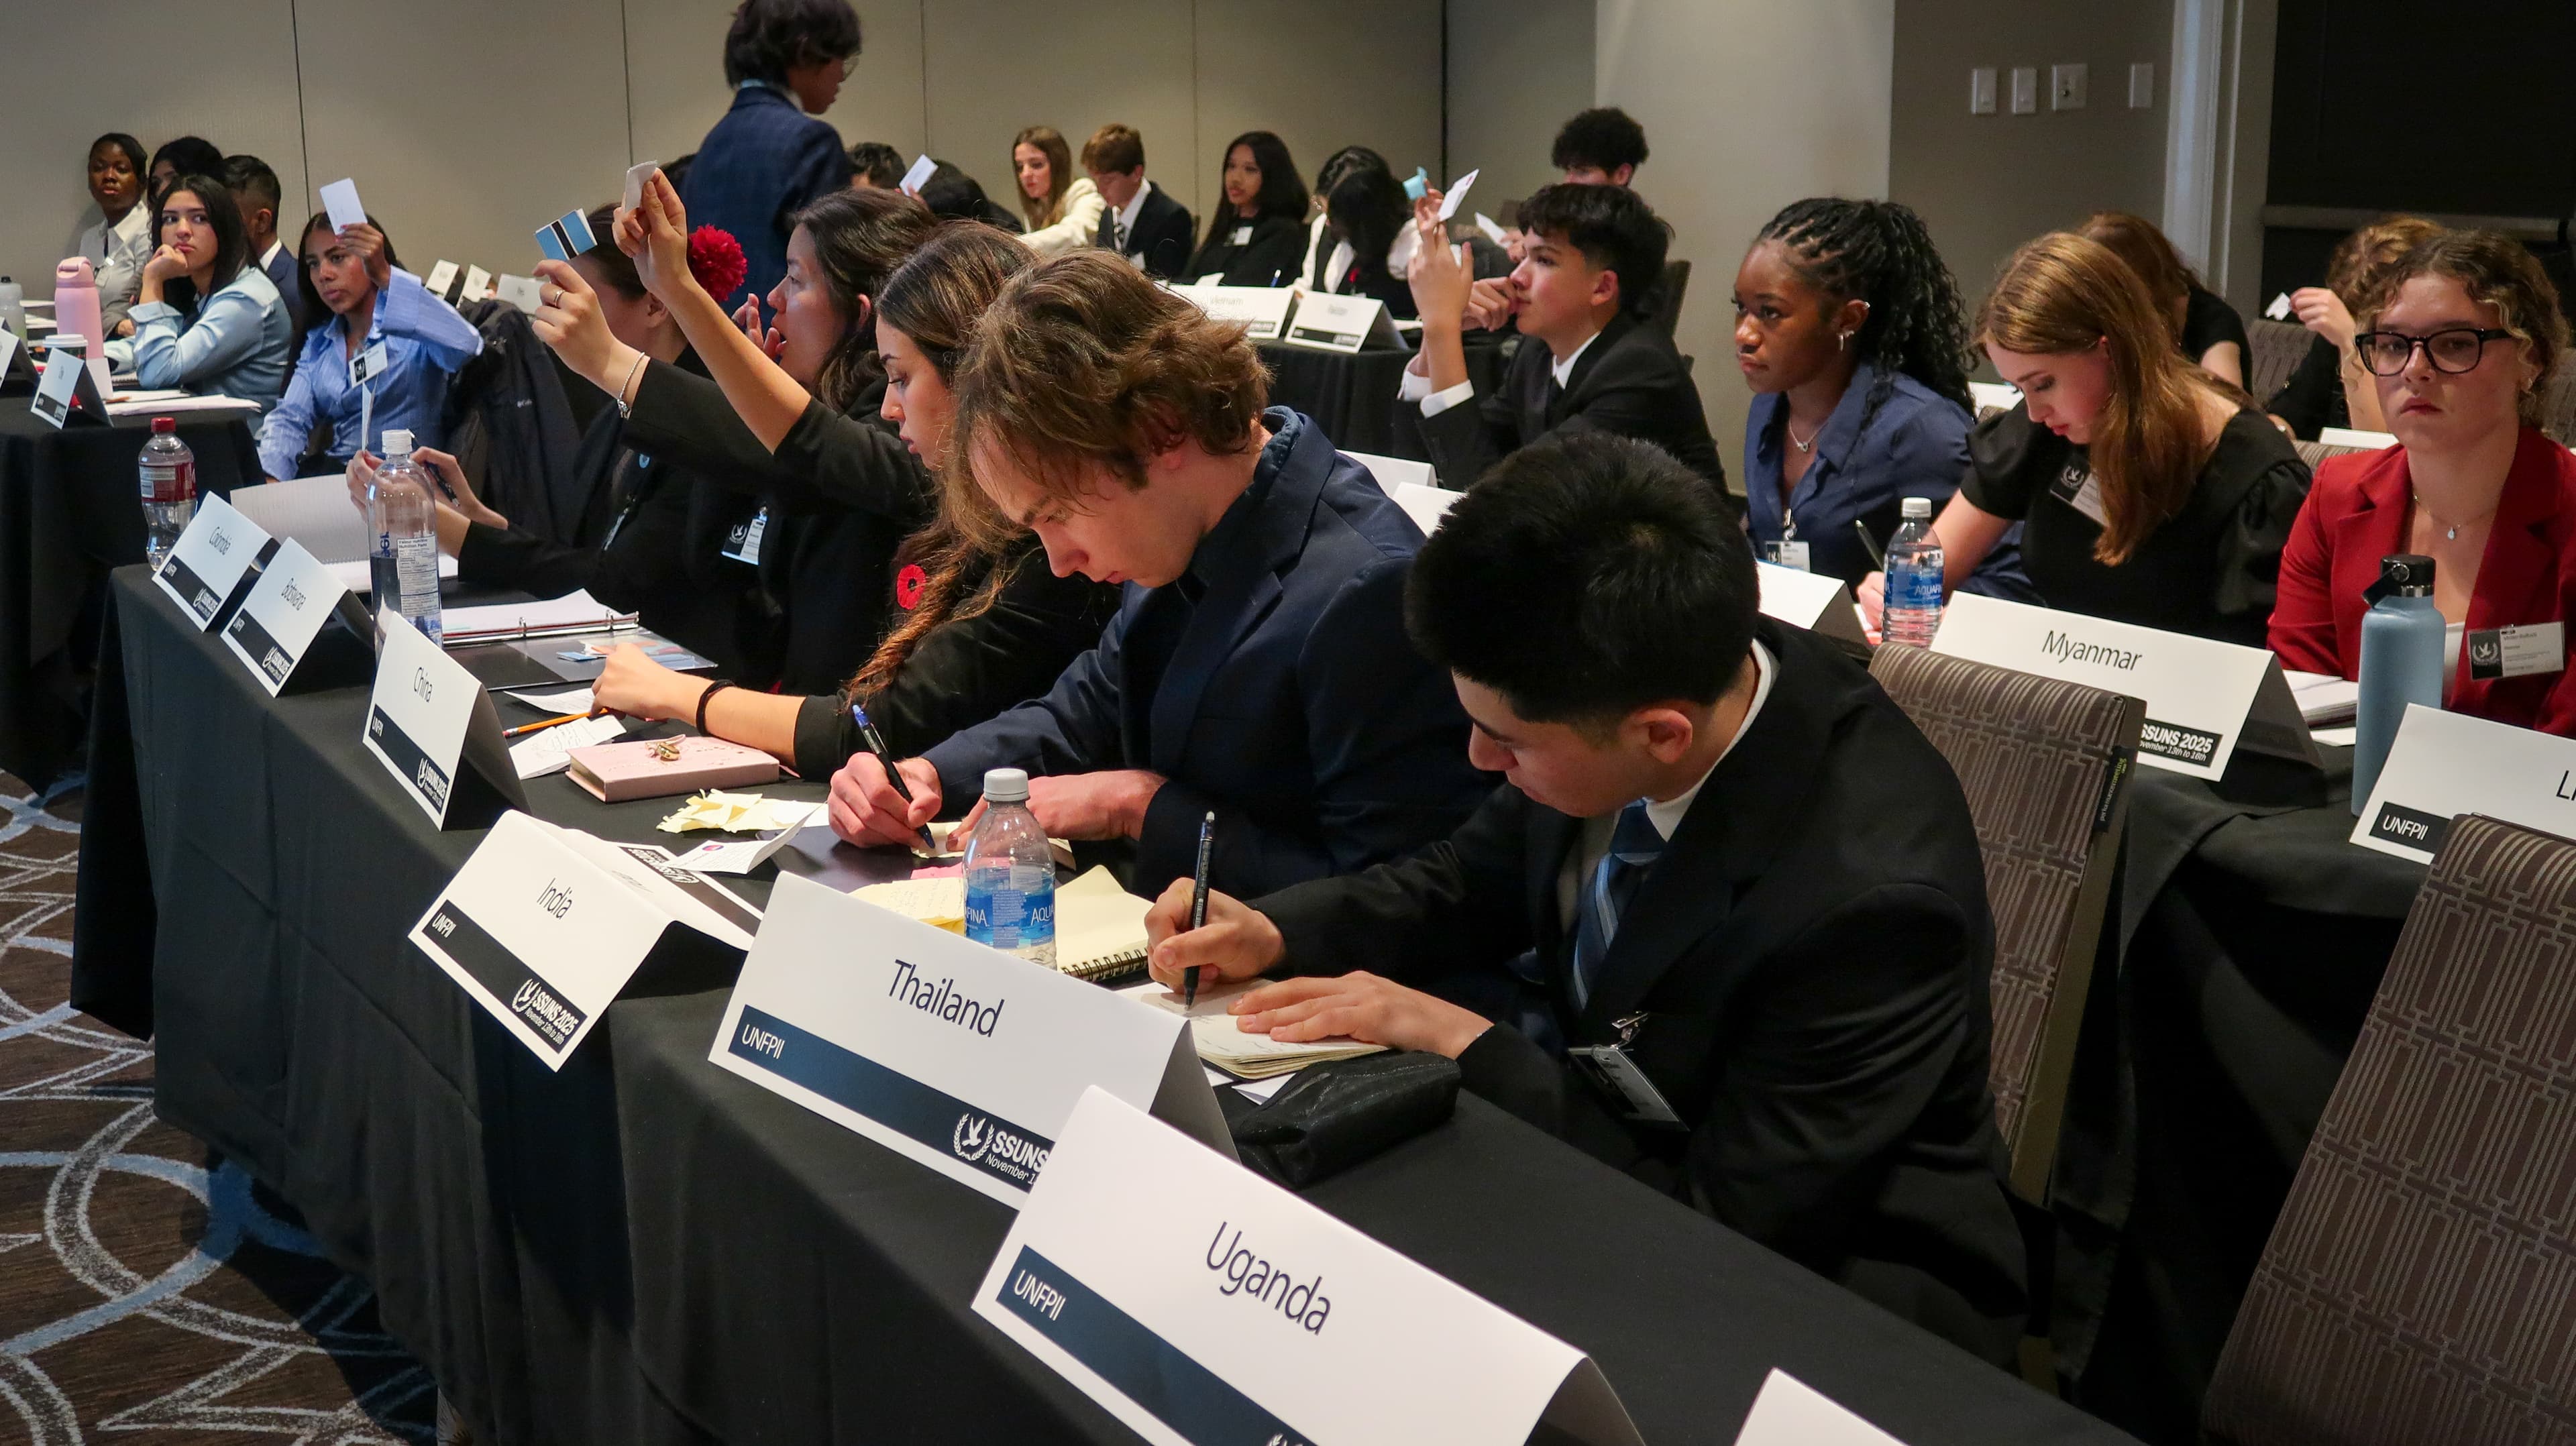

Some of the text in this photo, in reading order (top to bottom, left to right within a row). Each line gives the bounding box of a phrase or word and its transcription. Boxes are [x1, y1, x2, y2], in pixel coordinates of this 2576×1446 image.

[209, 526, 232, 555] Colombia
[281, 577, 306, 611] Botswana
[2042, 630, 2142, 671] Myanmar
[413, 667, 433, 703] China
[2180, 732, 2213, 754] 2025
[2383, 814, 2428, 840] UNFPII
[537, 877, 572, 920] India
[431, 912, 457, 938] UNFPII
[533, 991, 579, 1036] SSUNS 2025
[888, 959, 1005, 1038] Thailand
[741, 1023, 786, 1060] UNFPII
[985, 1154, 1029, 1180] November
[991, 1131, 1049, 1172] SSUNS
[1014, 1268, 1066, 1322] UNFPII
[1204, 1221, 1332, 1336] Uganda
